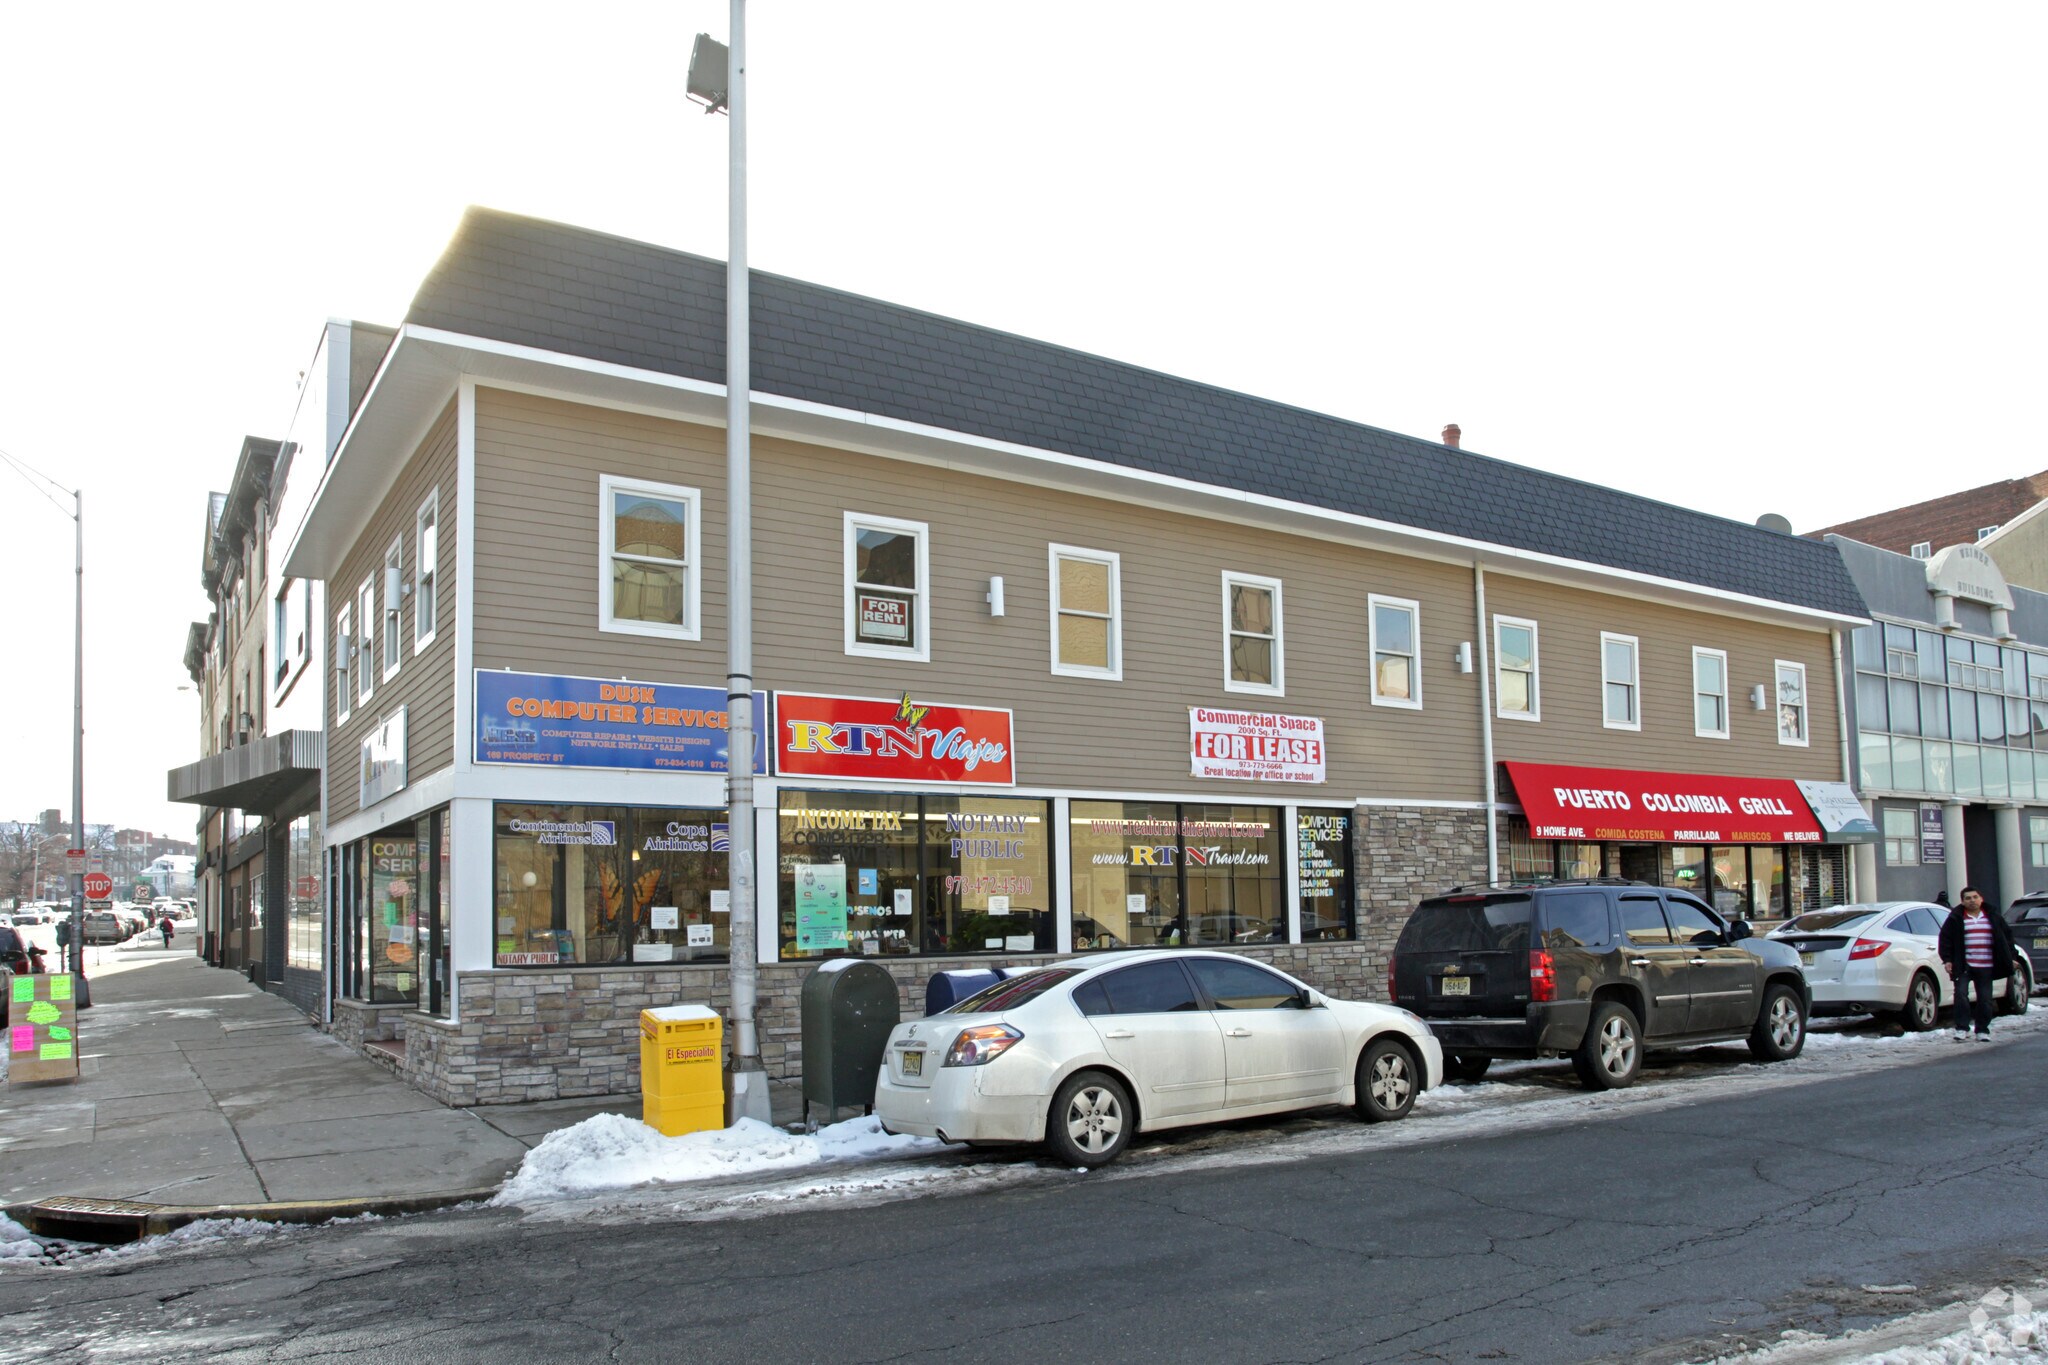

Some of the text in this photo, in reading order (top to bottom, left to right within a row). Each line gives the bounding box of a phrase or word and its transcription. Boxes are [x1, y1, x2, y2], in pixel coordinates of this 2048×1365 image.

[869, 600, 899, 613] FOR
[863, 610, 904, 624] RENT
[600, 684, 656, 704] DUSK
[506, 697, 638, 723] COMPUTER
[1197, 708, 1316, 731] Commercial Space
[541, 729, 711, 746] COMPUTER REPAIRS WEBSITE DESIGNS
[1238, 726, 1283, 737] 2000 Sq. Ft.
[570, 739, 685, 752] NETWORK INSTALL SALES
[787, 719, 1007, 771] RTN Viajes
[1200, 733, 1319, 764] FOR LEASE
[503, 751, 551, 761] PROSPECT
[552, 753, 565, 762] ST
[1204, 766, 1224, 776] Great
[1225, 767, 1251, 777] location
[1252, 769, 1263, 778] for
[1264, 770, 1284, 779] office
[1294, 771, 1314, 780] school
[1553, 787, 1631, 810] PUERTO
[1641, 793, 1732, 814] COLOMBIA
[1738, 797, 1793, 815] GRILL
[510, 818, 591, 832] Continental
[796, 808, 902, 831] INCOME TAX
[945, 812, 1027, 834] NOTARY
[538, 832, 591, 844] Airlines
[666, 821, 708, 840] Copa
[1536, 826, 1821, 841] 9 HOWE AVE. COMIDA COSTENA PARRILLADA MARISCOS WE DELIVER
[643, 836, 708, 851] Airlines
[950, 838, 1024, 860] PUBLIC
[1301, 842, 1316, 850] WEB
[379, 858, 416, 872] SER
[84, 880, 111, 892] STOP
[945, 875, 1032, 895] 973-472-4540
[832, 929, 879, 941] PAGINAS
[496, 953, 558, 965] NOTARY PUBLIC
[667, 1045, 715, 1060] El Especialito
